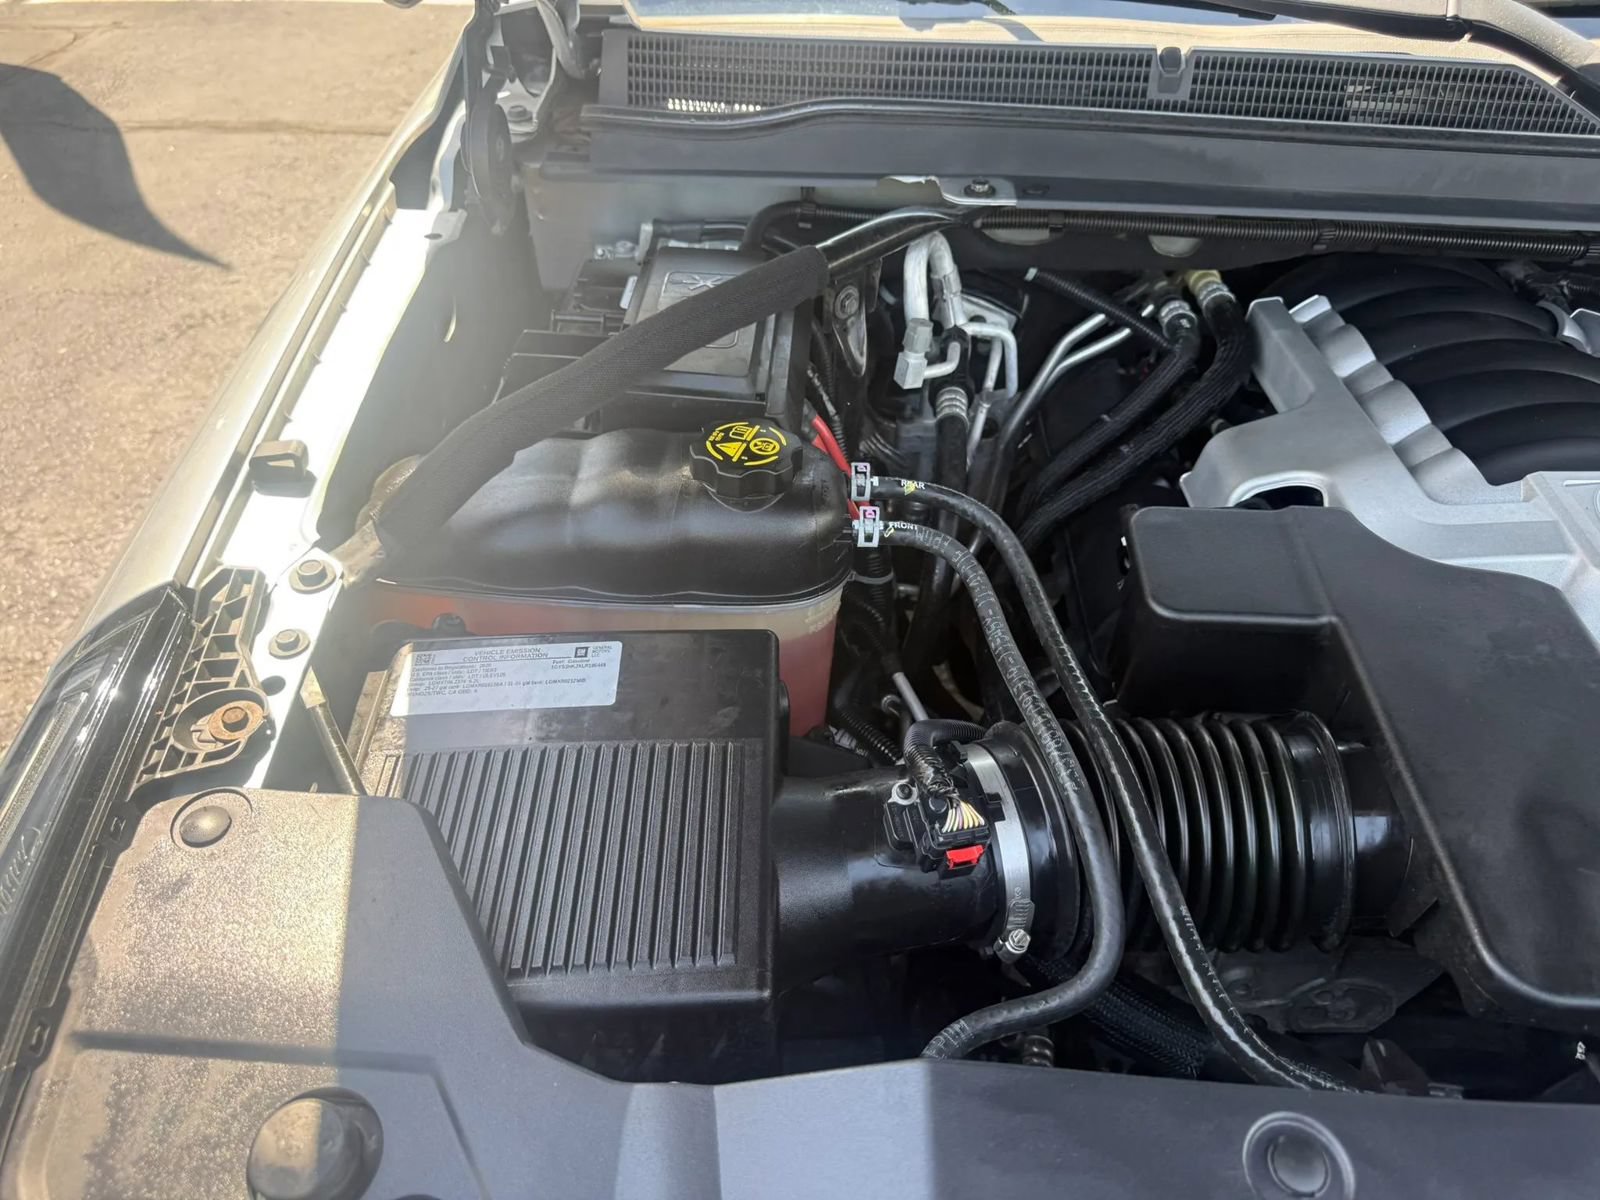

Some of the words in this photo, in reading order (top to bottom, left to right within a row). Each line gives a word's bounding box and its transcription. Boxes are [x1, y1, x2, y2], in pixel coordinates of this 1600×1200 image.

[889, 521, 918, 531] FRONT
[506, 647, 541, 655] EMISSION
[463, 655, 496, 663] CONTROL
[499, 653, 549, 661] INFORMATION
